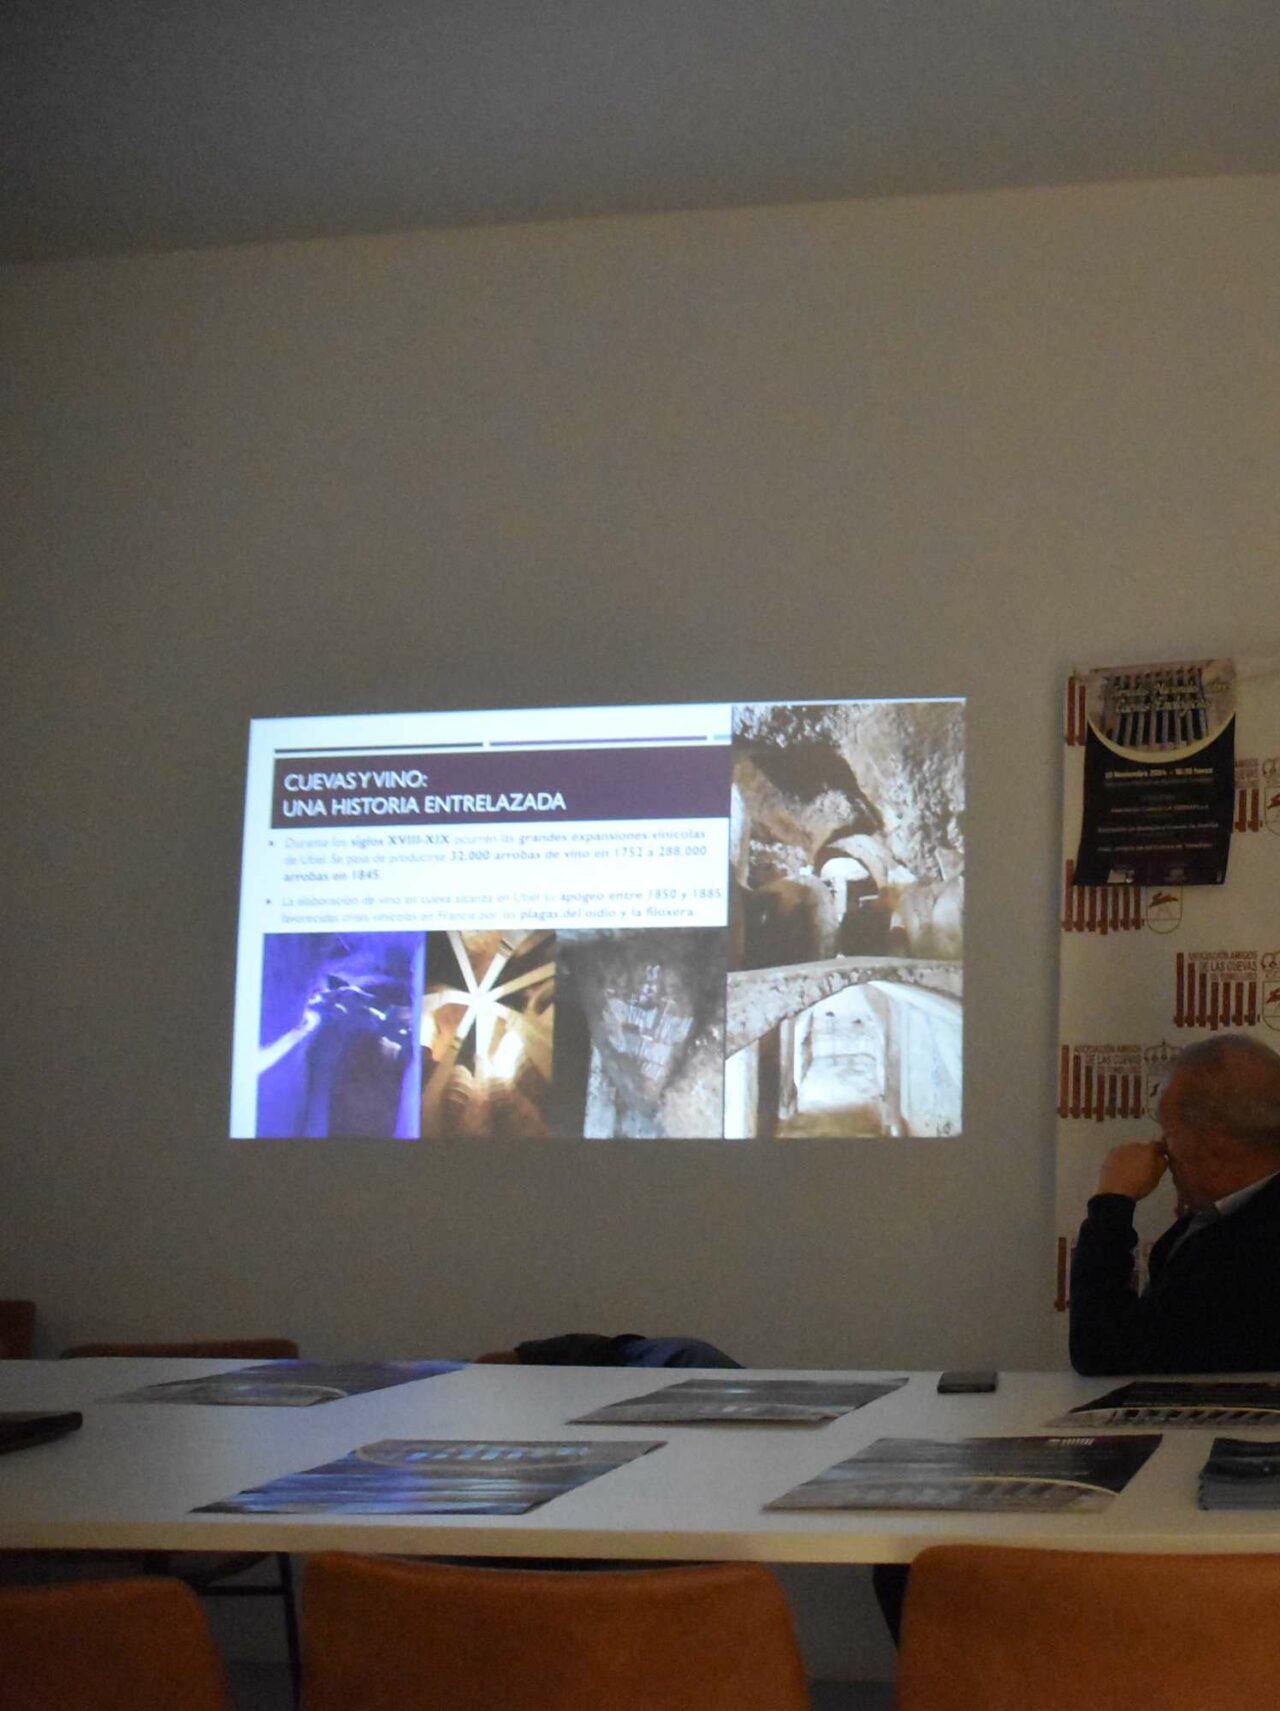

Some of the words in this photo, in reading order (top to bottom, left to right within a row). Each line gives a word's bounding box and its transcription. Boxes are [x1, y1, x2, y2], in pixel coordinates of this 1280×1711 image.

[283, 772, 356, 792] CUEVAS
[356, 771, 372, 789] Y
[372, 769, 429, 789] VINO:
[282, 799, 326, 817] UNA
[330, 795, 421, 816] HISTORIA
[423, 792, 568, 814] ENTRELAZADA
[351, 836, 384, 850] siglos
[518, 831, 567, 846] grandes
[570, 830, 648, 847] expansiones
[449, 850, 491, 862] 32.000
[494, 849, 541, 861] arrobas
[545, 849, 560, 860] de
[563, 848, 590, 860] vino
[594, 849, 609, 859] en
[613, 846, 643, 858] 1752
[658, 845, 708, 857] 288.000
[282, 870, 329, 882] arrobas
[332, 871, 347, 882] en
[559, 891, 605, 906] apogeo
[607, 890, 643, 901] entre
[647, 888, 678, 900] 1850
[520, 908, 558, 922] plagas
[562, 907, 581, 919] del
[631, 907, 643, 918] la
[646, 906, 695, 918] filoxera
